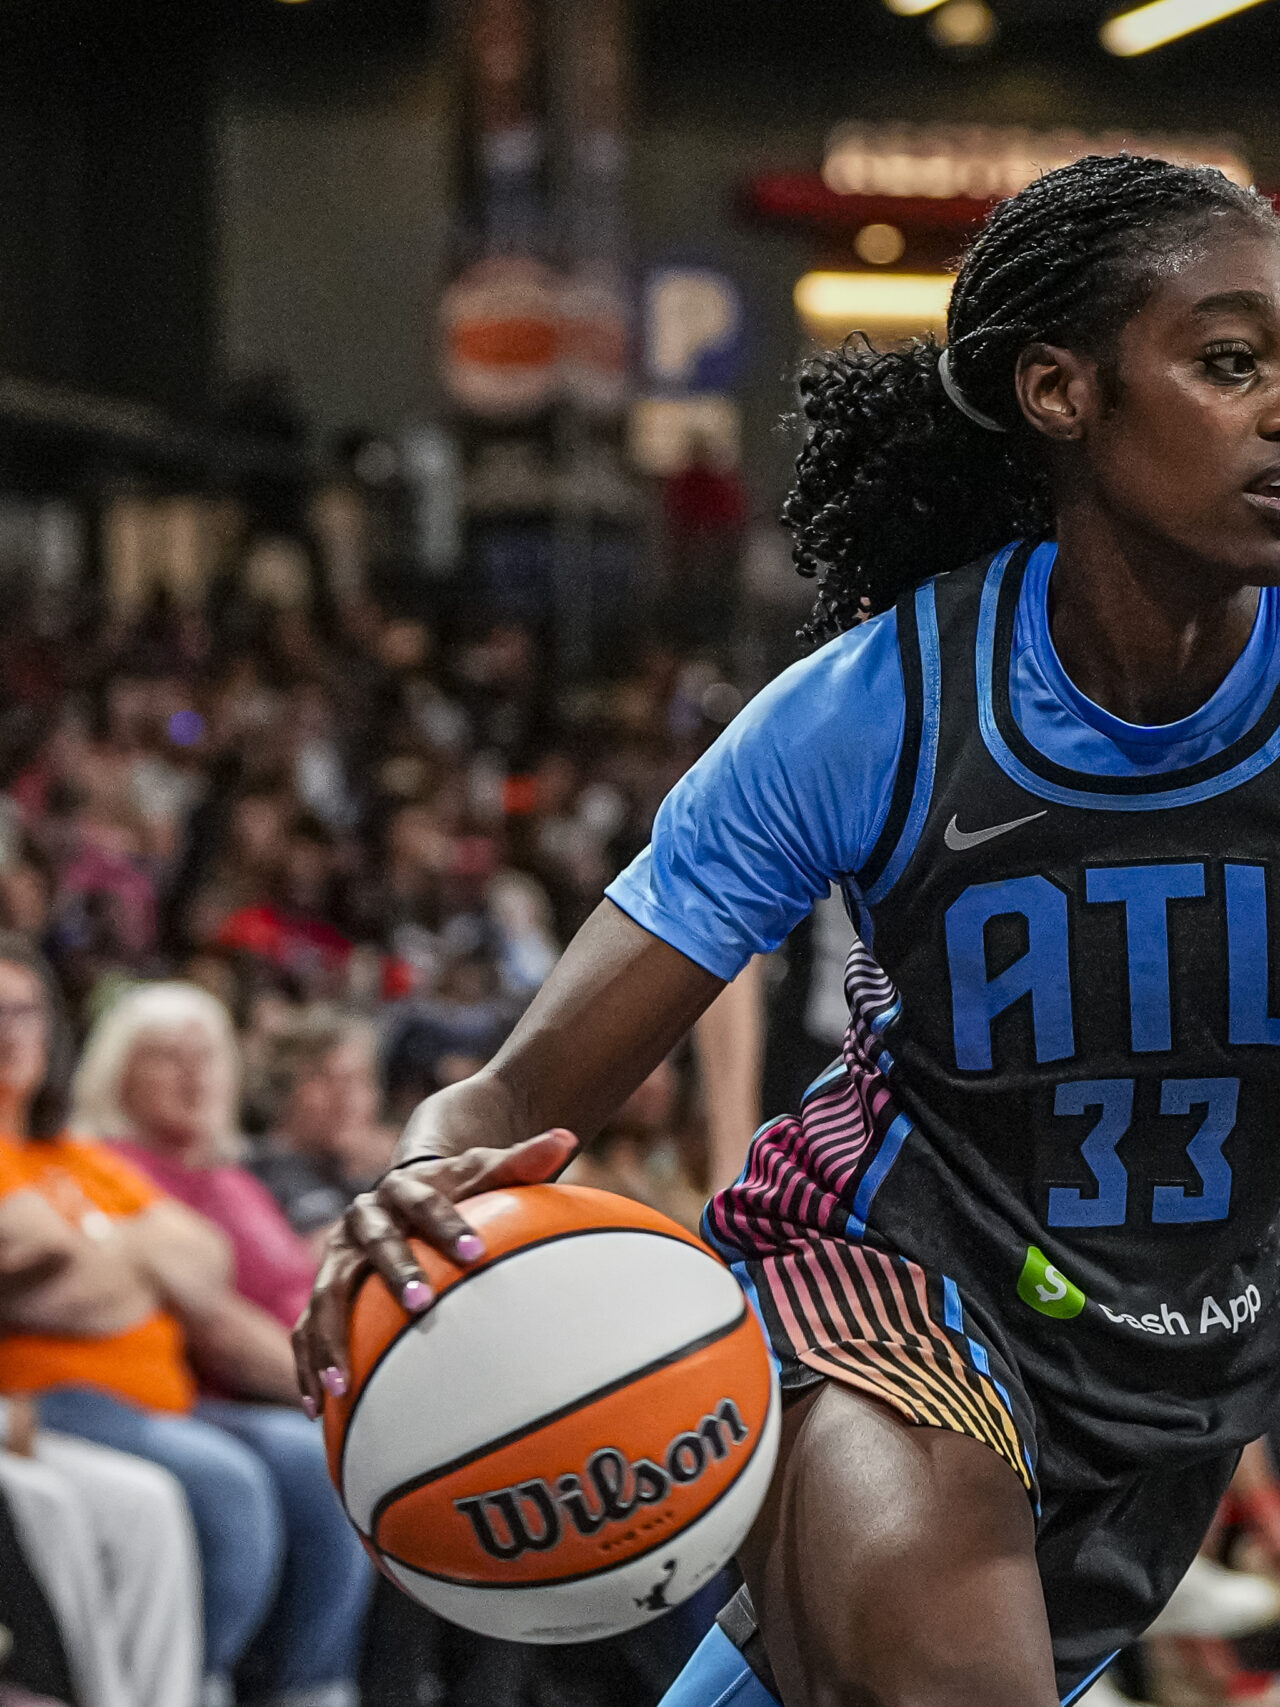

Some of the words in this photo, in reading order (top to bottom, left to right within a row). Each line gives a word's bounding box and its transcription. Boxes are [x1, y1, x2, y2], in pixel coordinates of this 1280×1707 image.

[1047, 1076, 1241, 1228] 33
[1200, 1283, 1262, 1334] App
[453, 1397, 748, 1560] Wilson
